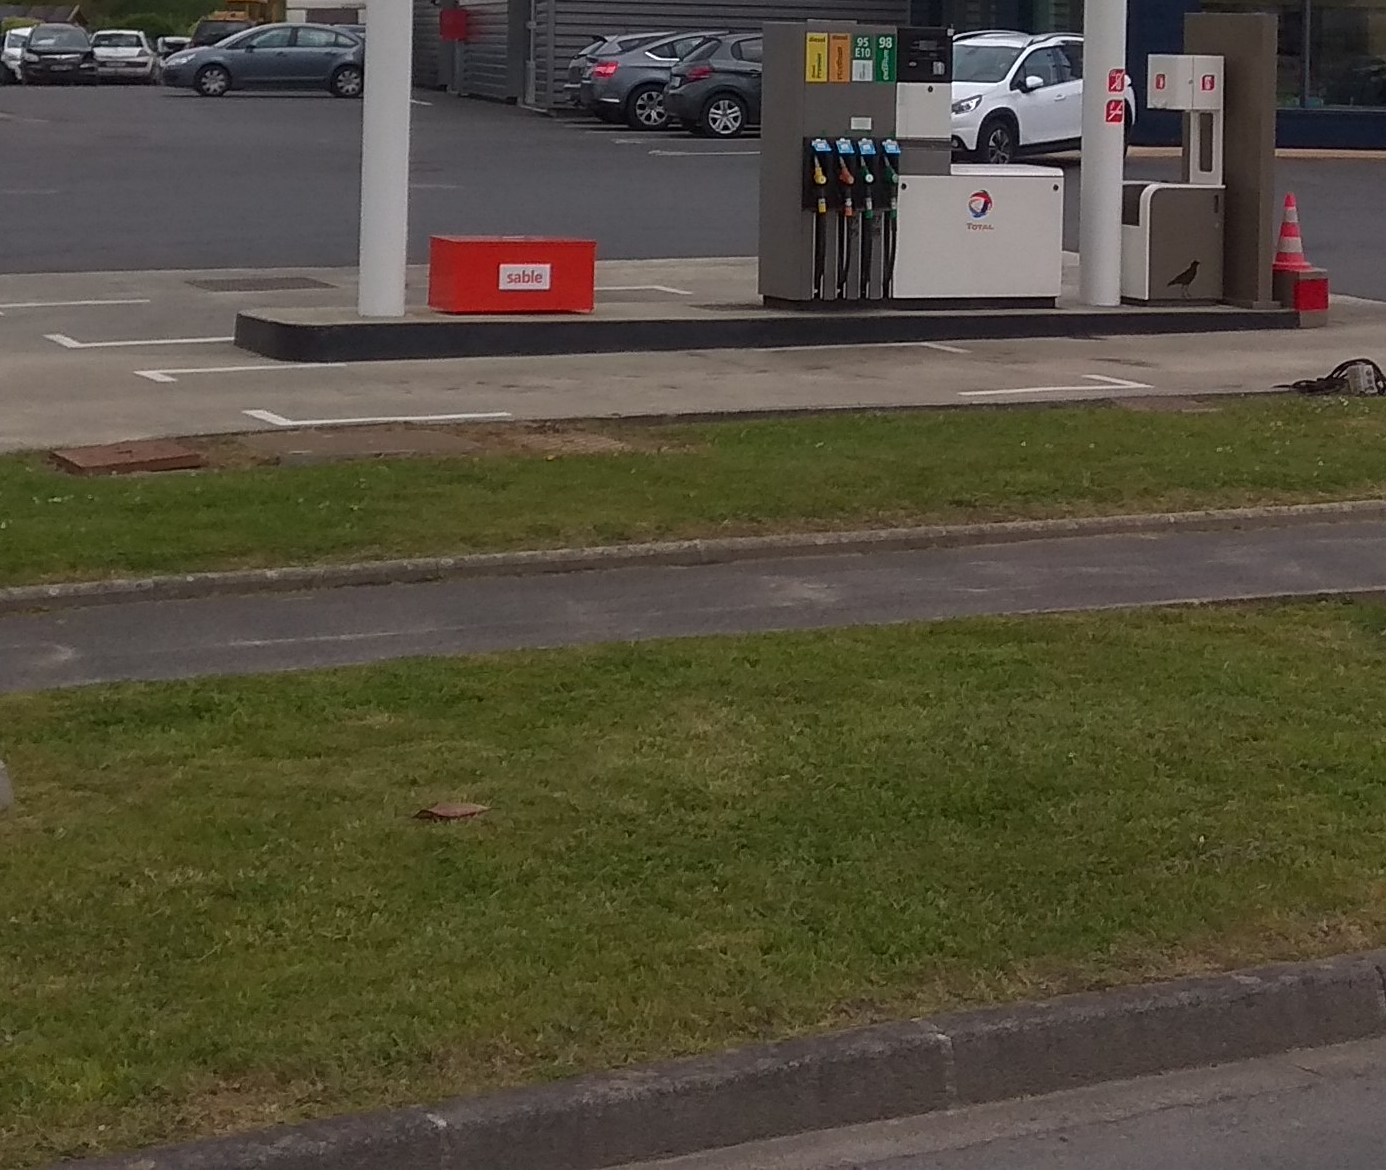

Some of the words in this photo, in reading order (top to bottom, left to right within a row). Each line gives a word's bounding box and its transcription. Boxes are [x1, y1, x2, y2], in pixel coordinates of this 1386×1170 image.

[856, 37, 869, 47] 95
[879, 36, 893, 48] 98
[855, 48, 871, 58] E10
[966, 222, 994, 230] TOTAL
[506, 269, 544, 285] sable
